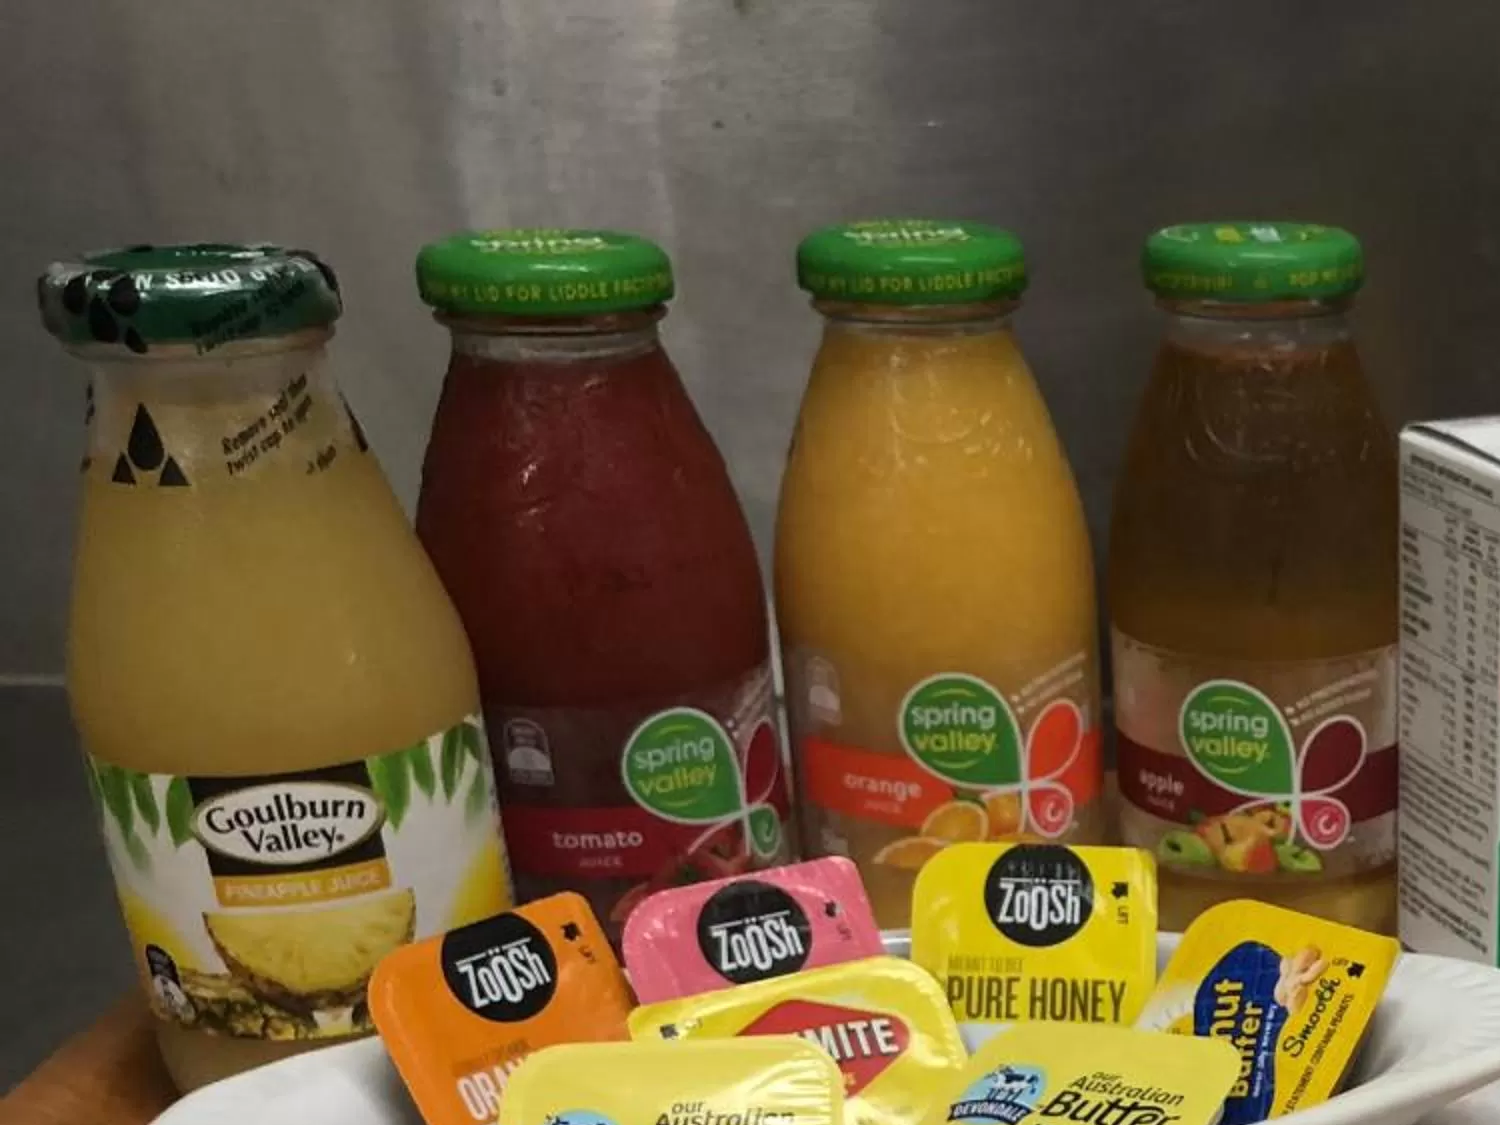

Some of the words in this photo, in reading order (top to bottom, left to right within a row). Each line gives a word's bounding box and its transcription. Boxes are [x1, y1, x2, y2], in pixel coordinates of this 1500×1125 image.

[911, 701, 996, 729] spring
[1189, 708, 1270, 738] spring
[633, 736, 716, 774] spring
[914, 729, 998, 755] valley
[1191, 735, 1270, 763] valley
[638, 763, 717, 797] valley
[843, 772, 923, 801] orange
[1139, 768, 1185, 797] apple
[204, 793, 366, 836] Goulburn
[241, 825, 337, 864] Valley
[552, 830, 644, 850] tomato
[947, 975, 1021, 1021] PURE
[1029, 977, 1127, 1023] HONEY
[1210, 978, 1245, 1042] nut
[1282, 976, 1341, 1059] Smooth
[800, 1016, 901, 1061] MITE
[1070, 1075, 1185, 1106] Australian
[671, 1100, 705, 1115] our
[953, 1101, 1027, 1122] DEVONDALE
